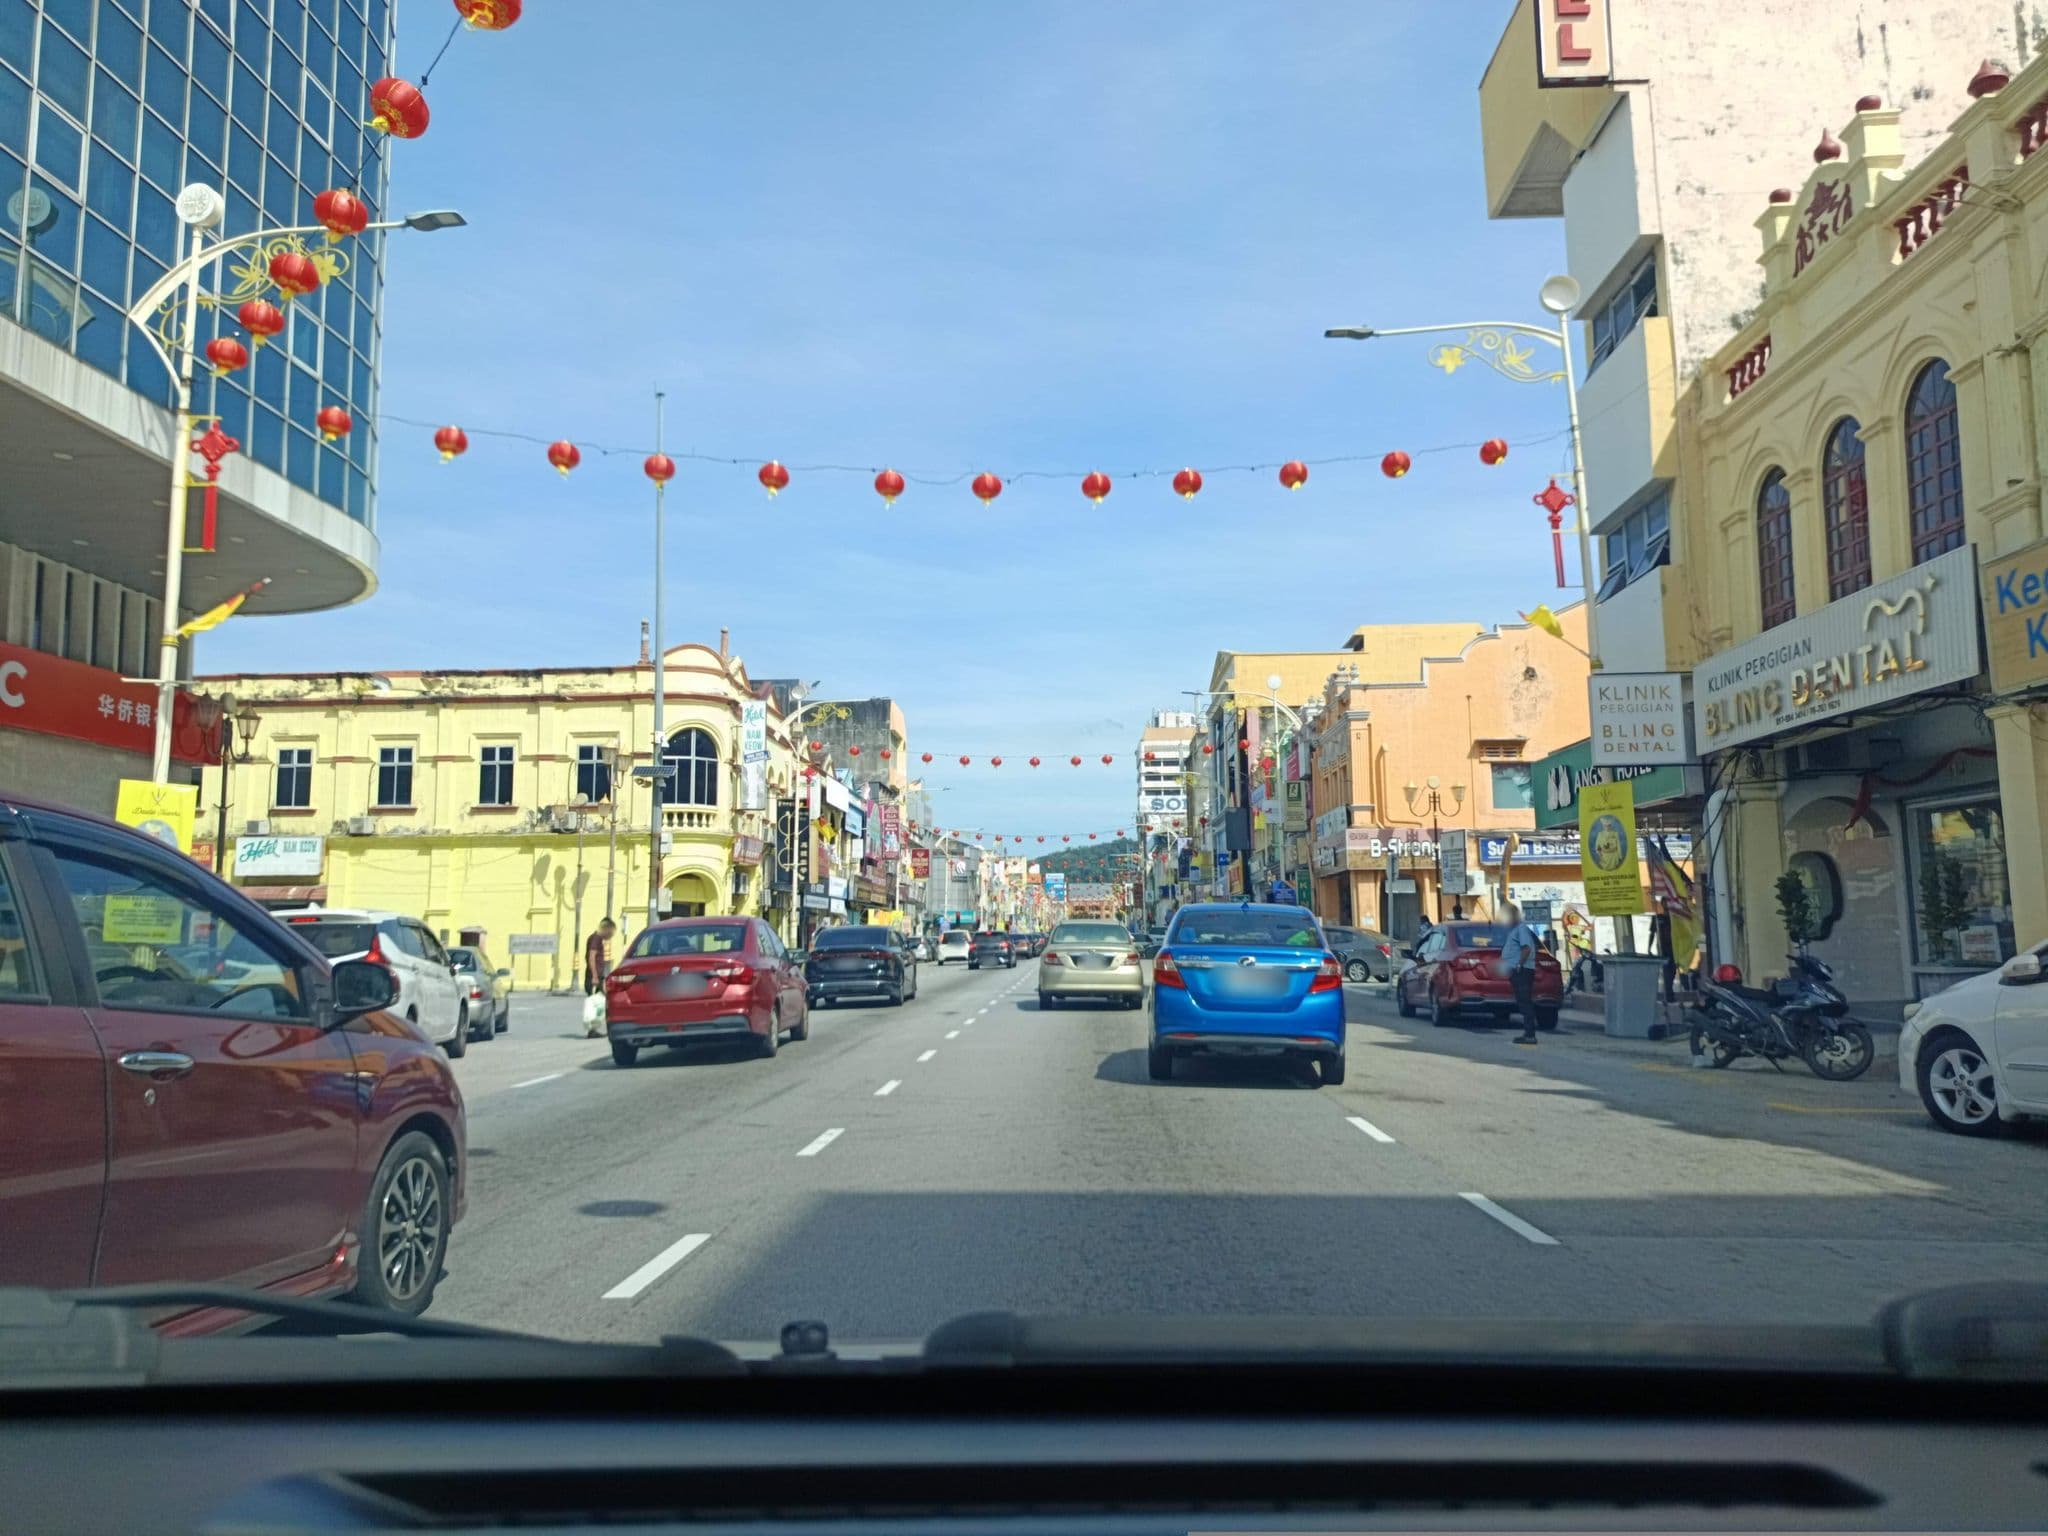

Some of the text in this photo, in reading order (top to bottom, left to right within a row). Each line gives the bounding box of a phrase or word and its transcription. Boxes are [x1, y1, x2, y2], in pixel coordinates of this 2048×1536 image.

[1995, 566, 2048, 614] Ke
[1708, 637, 1812, 693] KLINIK PERGIGIAN
[1599, 684, 1672, 701] KLINIK
[1704, 631, 1926, 736] BLING DENTAL
[98, 693, 159, 728] 华侨银
[1600, 703, 1674, 713] PERGIGIAN
[1602, 723, 1674, 738] BLING
[1604, 742, 1675, 753] DENTAL
[239, 839, 281, 862] Hotel
[1370, 838, 1440, 861] B-Strong
